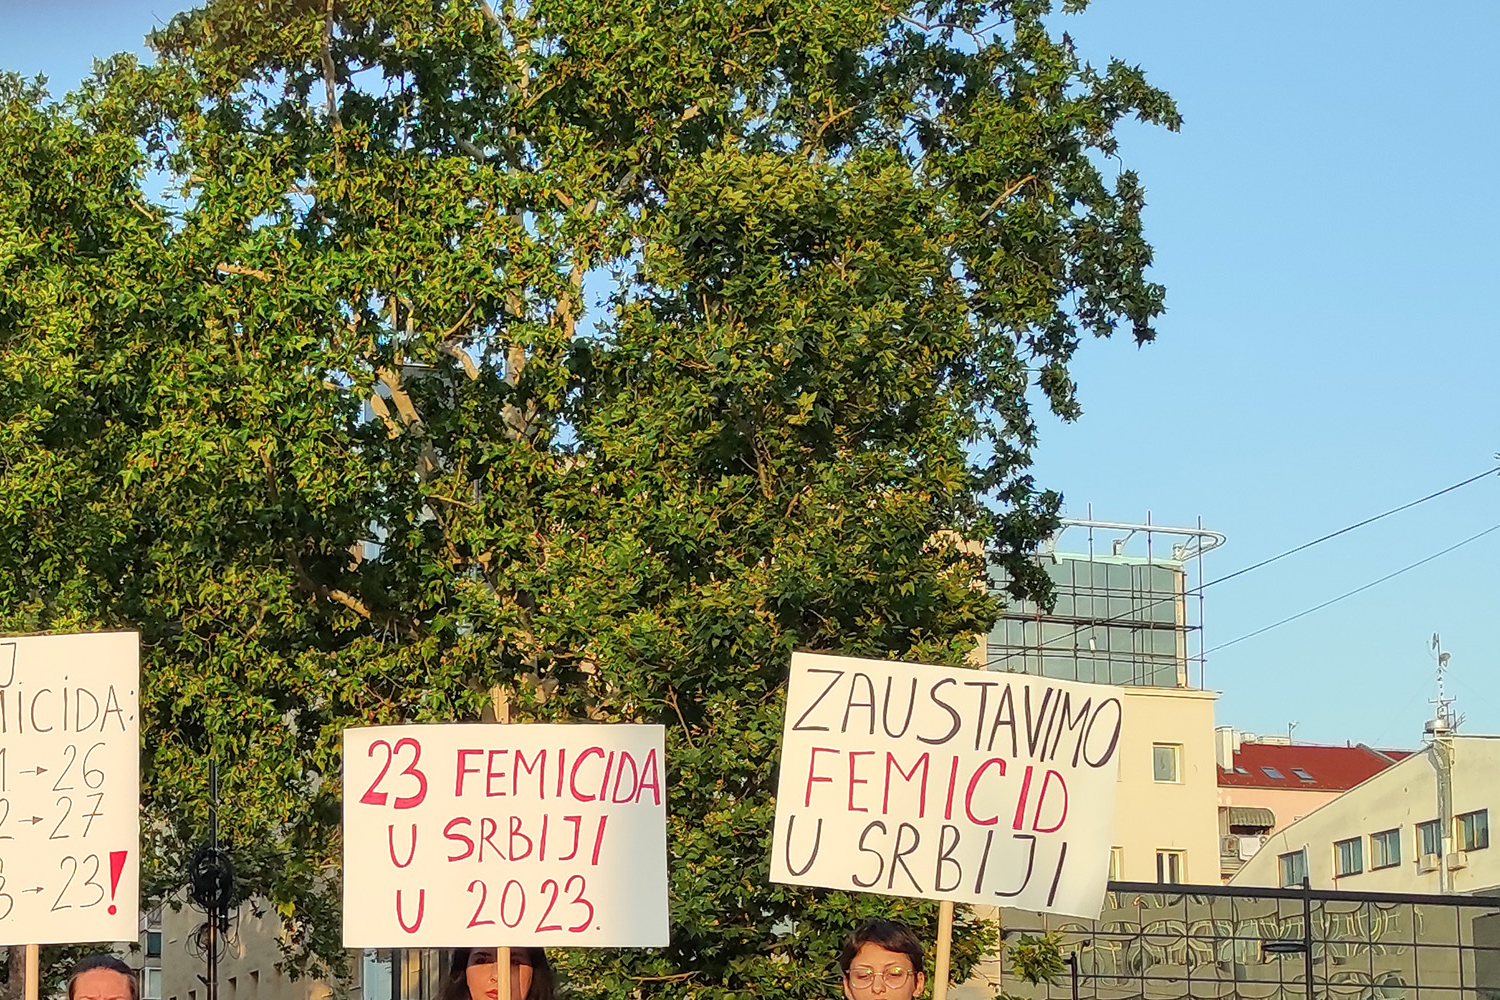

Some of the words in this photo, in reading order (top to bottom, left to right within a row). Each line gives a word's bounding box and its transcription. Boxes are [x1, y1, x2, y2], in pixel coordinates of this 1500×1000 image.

[792, 668, 1123, 768] ZAUSTAVIMO
[52, 742, 107, 792] 26
[359, 737, 428, 810] 23
[455, 746, 662, 806] FEMICIDA
[804, 746, 1069, 834] FEMICID
[49, 792, 104, 840] 27
[388, 823, 417, 868] U
[443, 814, 609, 866] SRBIJI
[785, 815, 823, 877] U
[851, 820, 1068, 908] SRBIJI
[396, 889, 425, 934] U
[466, 875, 602, 934] 2023.
